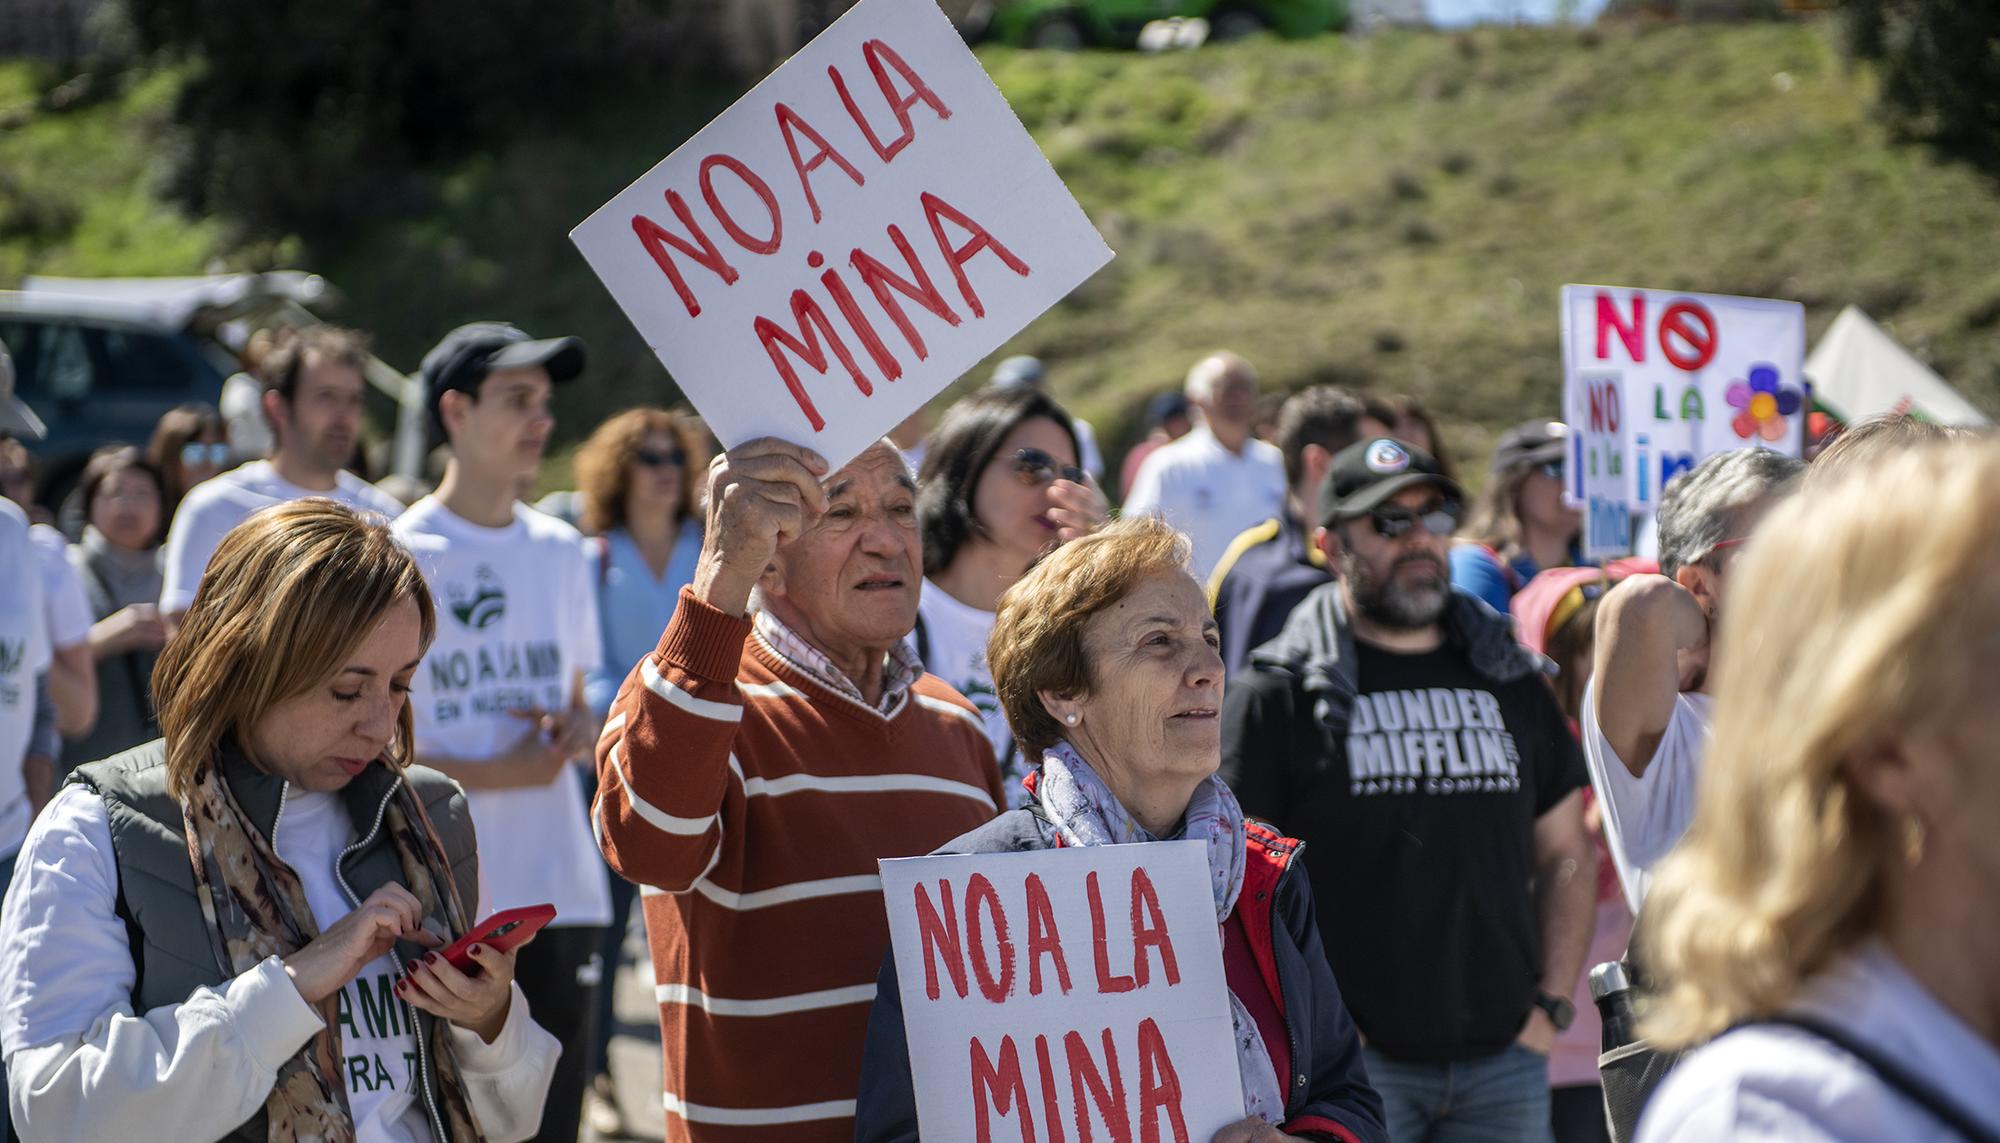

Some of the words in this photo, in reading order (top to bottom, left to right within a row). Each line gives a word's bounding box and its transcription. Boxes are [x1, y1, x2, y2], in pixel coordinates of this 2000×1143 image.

[631, 153, 782, 318] NO
[775, 102, 865, 224] A
[827, 38, 953, 163] LA
[1594, 288, 1718, 372] NO
[1588, 380, 1620, 433] NO
[1654, 384, 1705, 420] LA
[430, 651, 472, 691] NO
[478, 646, 498, 682] A
[436, 699, 463, 721] EN
[1350, 686, 1506, 735] DUNDER
[1350, 777, 1418, 796] PAPER
[1424, 775, 1521, 795] COMPANY
[914, 872, 1016, 1003] NO
[1025, 872, 1073, 996] A
[1086, 867, 1181, 994] LA
[970, 1017, 1190, 1143] MINA
